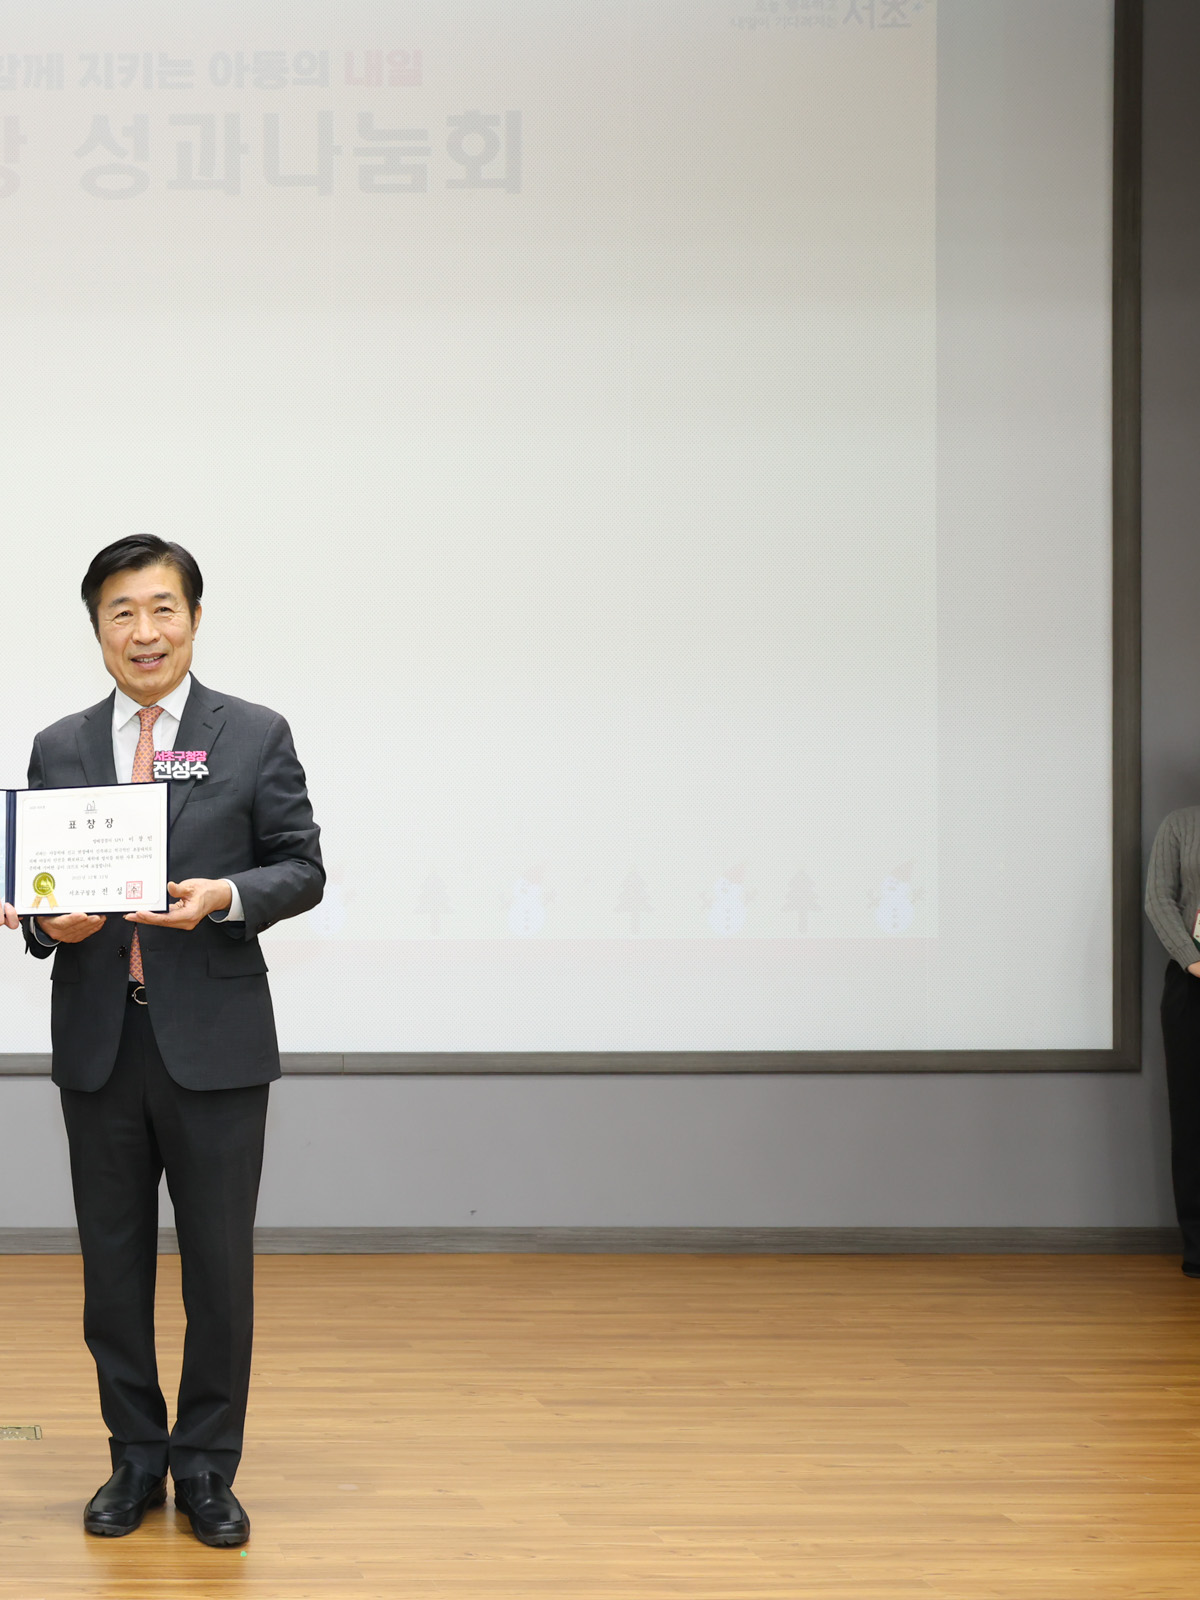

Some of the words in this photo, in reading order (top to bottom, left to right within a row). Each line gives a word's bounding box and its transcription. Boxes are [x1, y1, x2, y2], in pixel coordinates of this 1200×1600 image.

[78, 50, 196, 91] 지키는
[208, 48, 330, 90] 아동의
[344, 48, 424, 88] 내일
[73, 108, 523, 201] 성과나눔회
[153, 750, 208, 762] 서초구청장
[153, 761, 210, 780] 전성수
